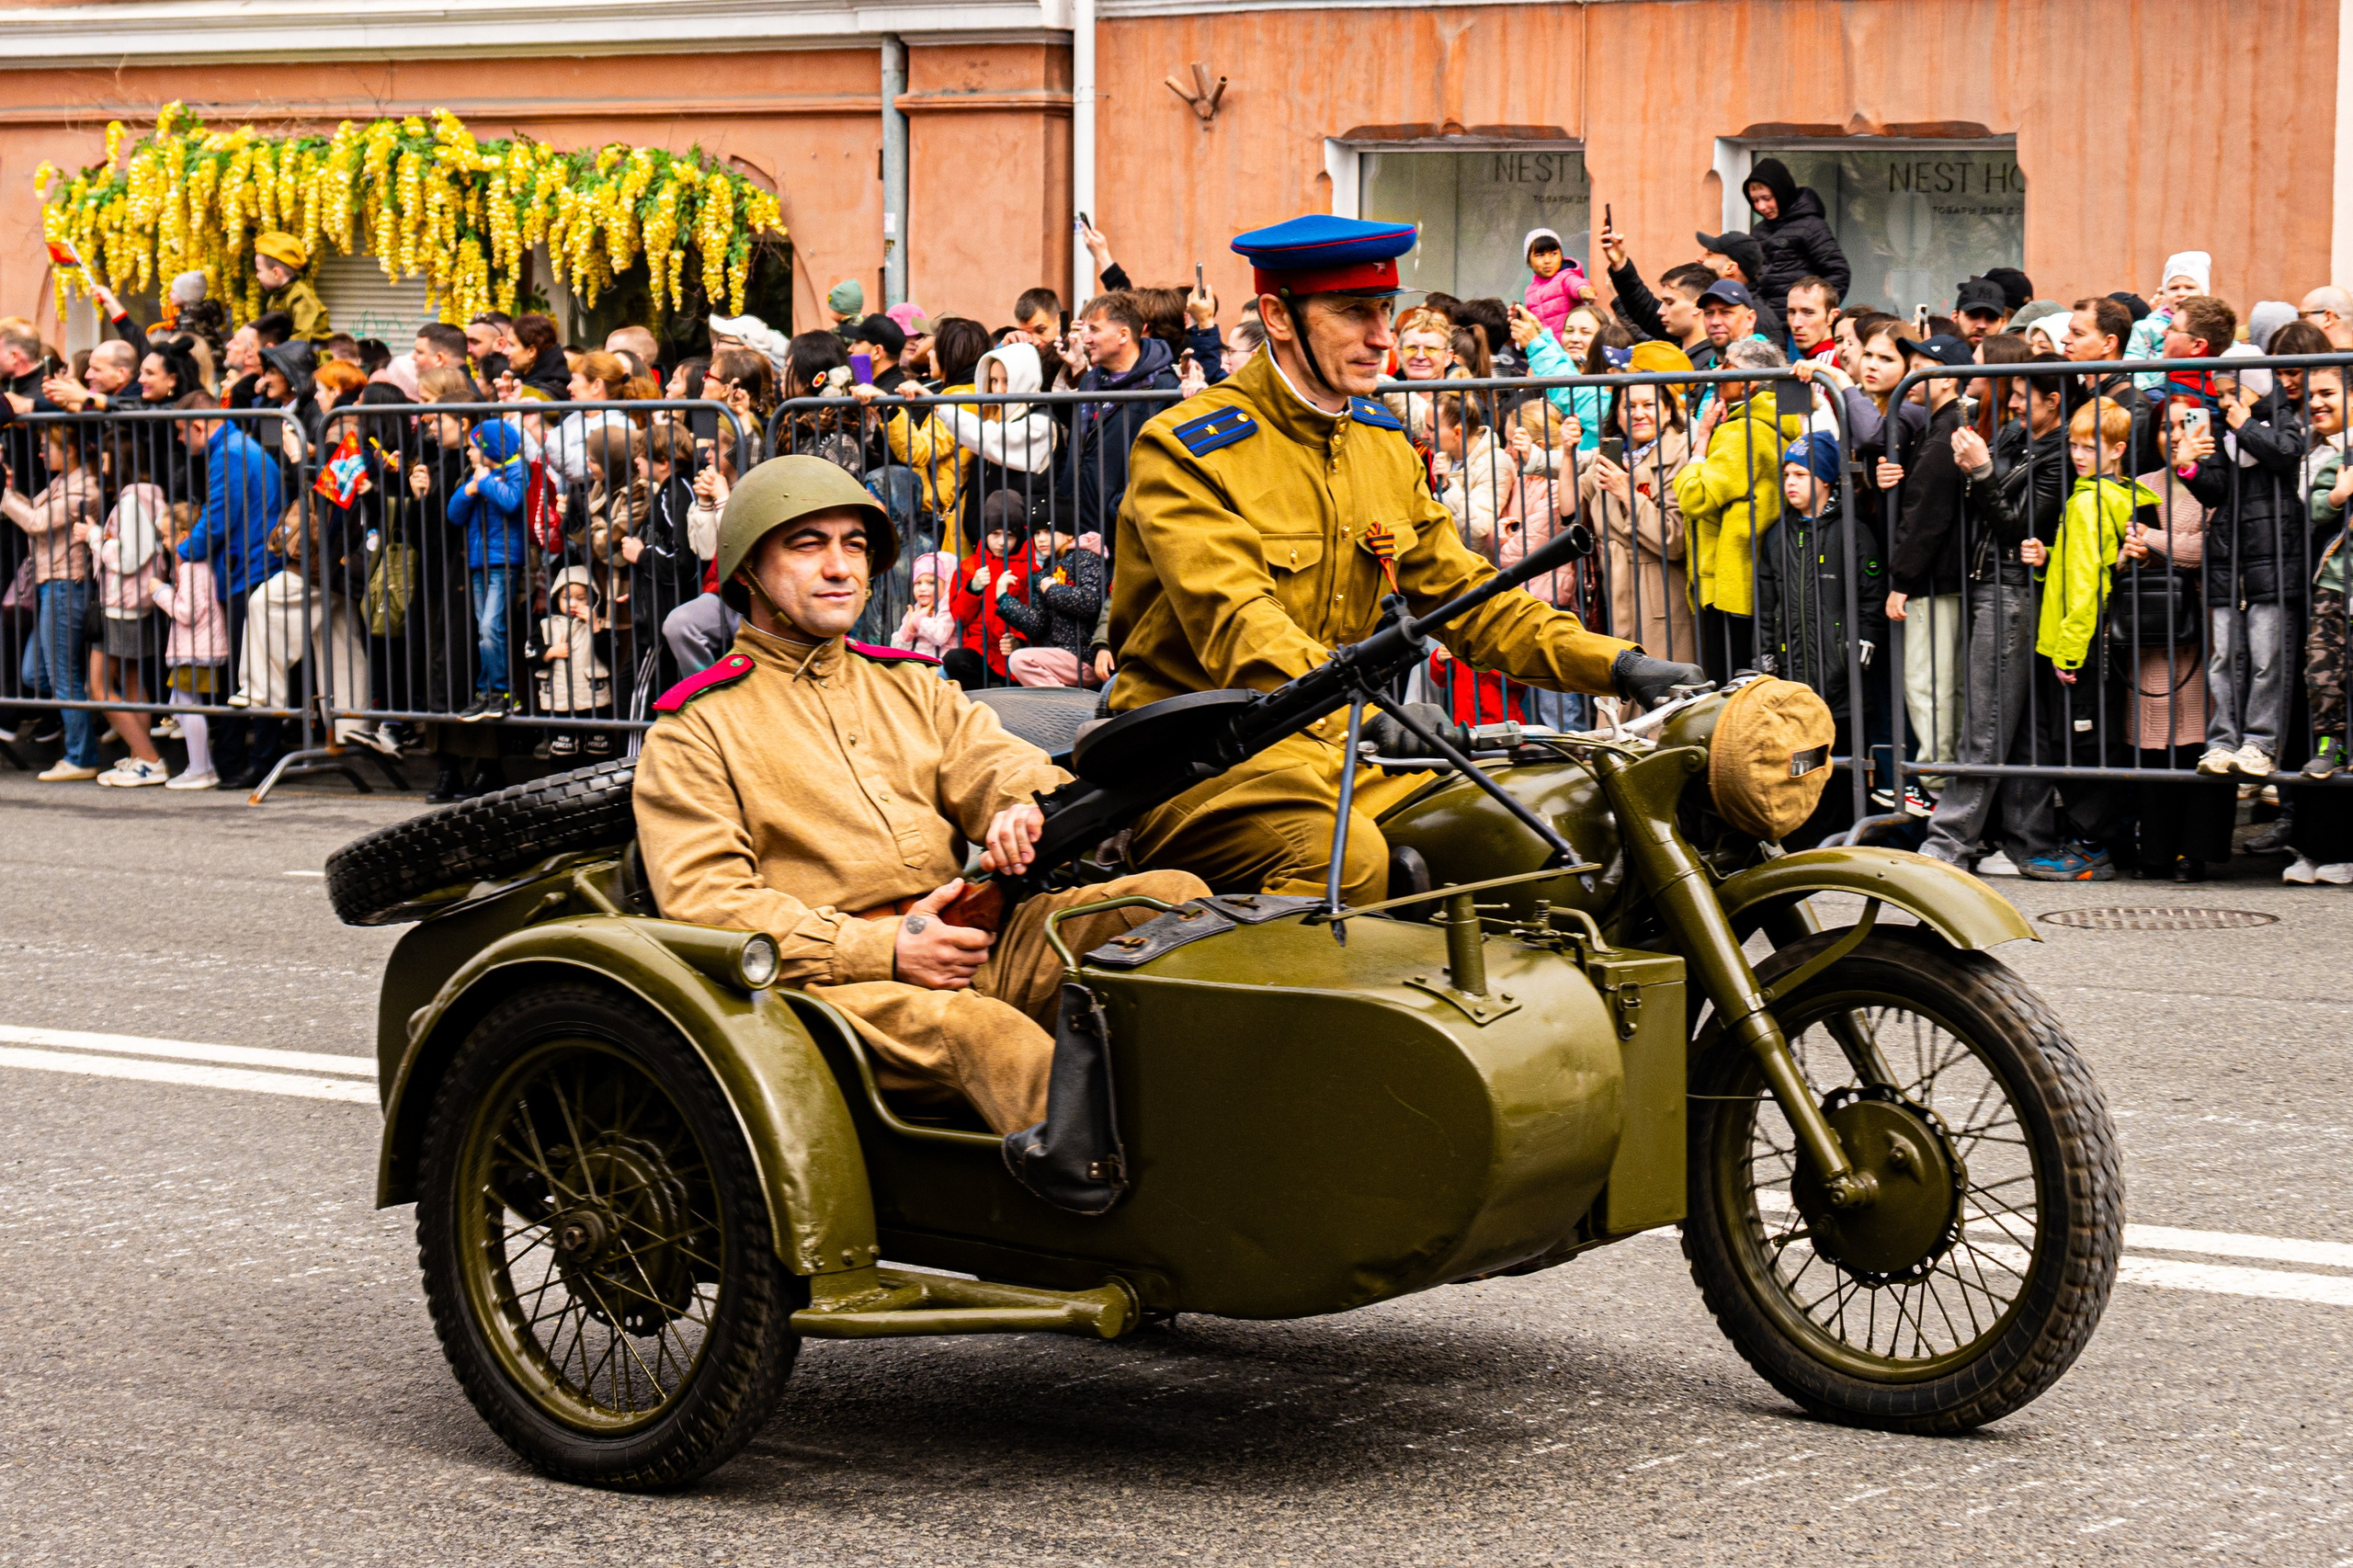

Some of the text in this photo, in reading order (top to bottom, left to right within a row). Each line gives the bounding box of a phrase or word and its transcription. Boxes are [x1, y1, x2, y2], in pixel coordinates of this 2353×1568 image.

[1495, 153, 1570, 183] NEST
[1890, 162, 1973, 193] NEST
[1932, 206, 1975, 215] ТОВАРЫ
